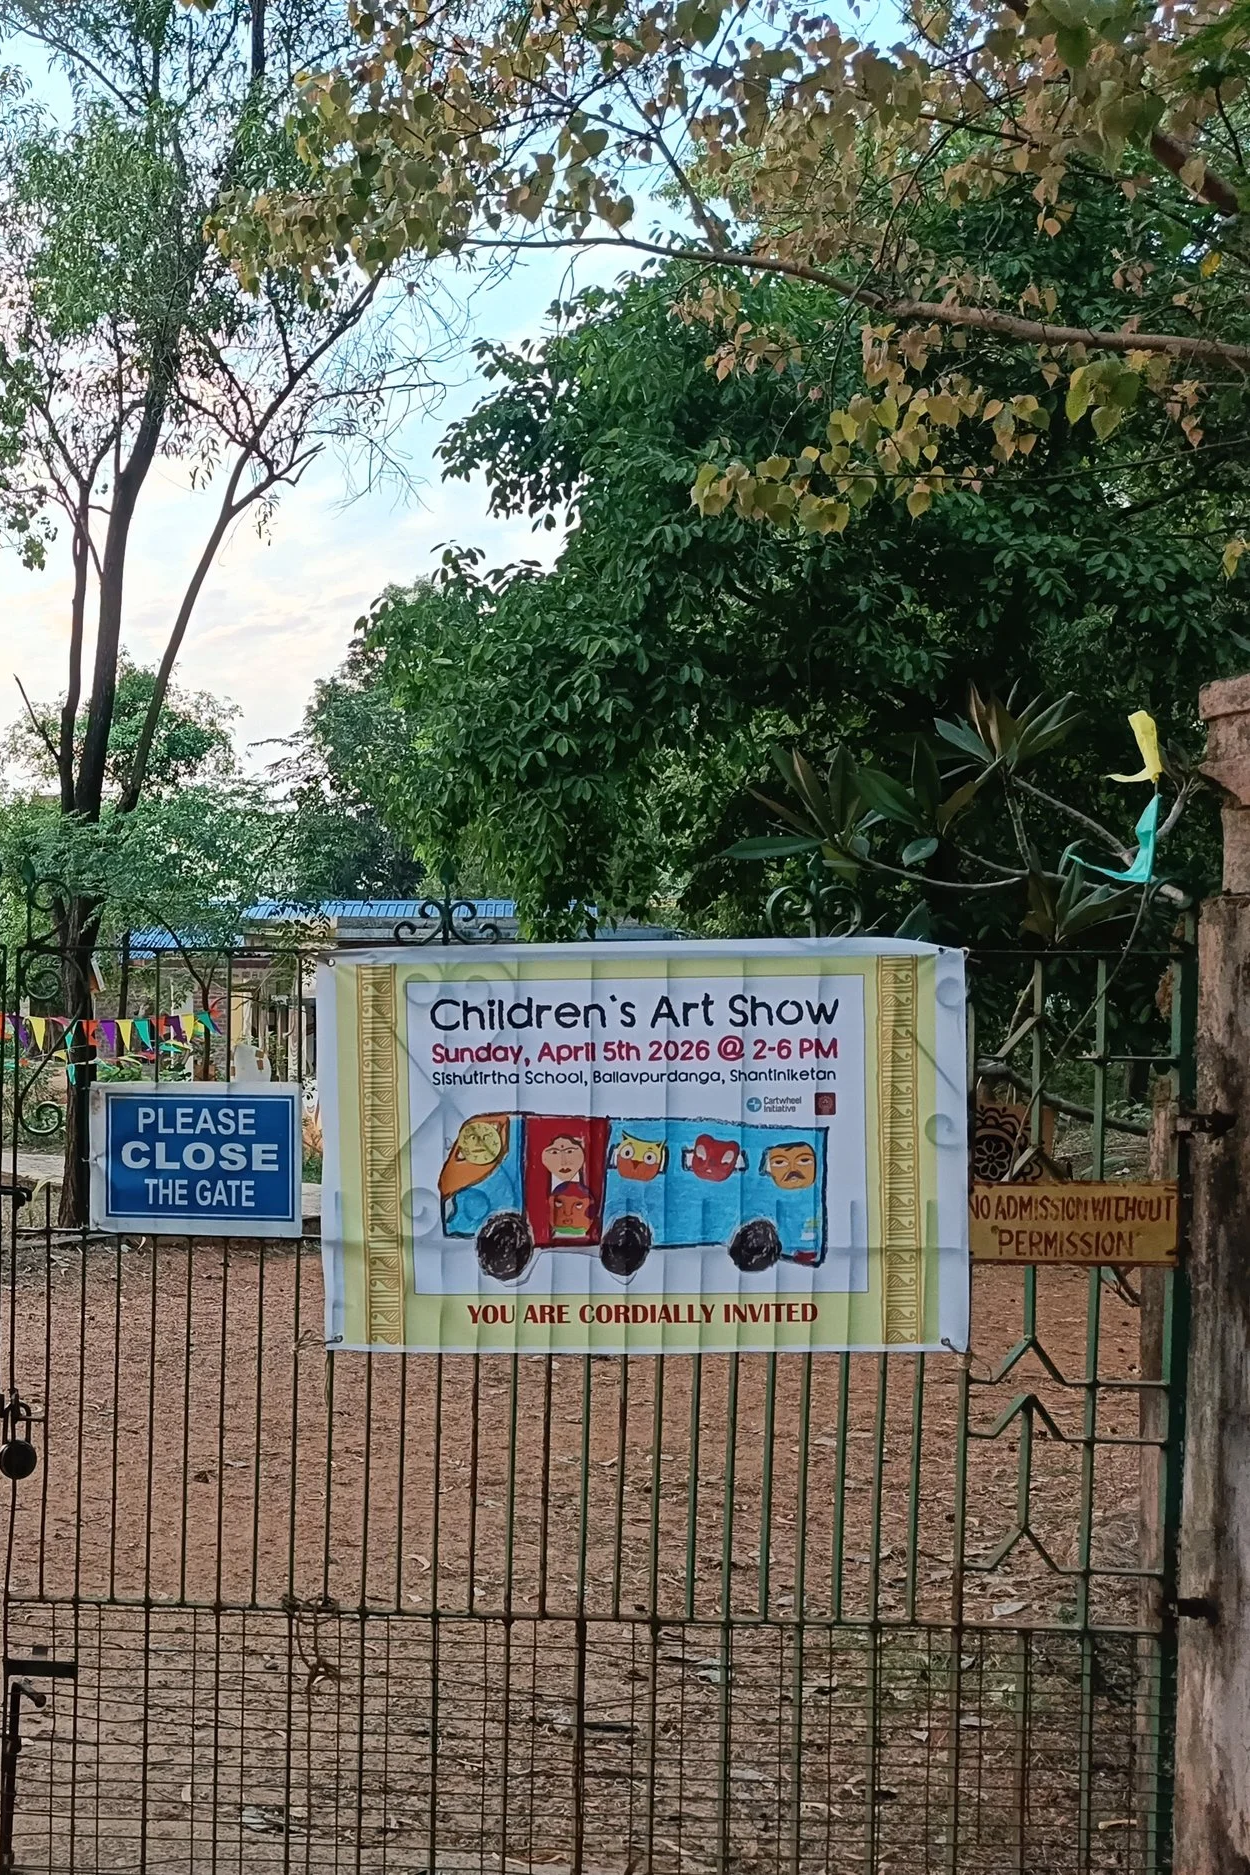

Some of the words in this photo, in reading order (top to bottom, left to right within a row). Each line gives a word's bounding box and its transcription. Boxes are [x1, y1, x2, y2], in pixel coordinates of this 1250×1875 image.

[430, 994, 636, 1031] Children's
[650, 992, 714, 1028] Art
[728, 994, 839, 1027] Show
[432, 1042, 530, 1067] Sunday,
[538, 1041, 596, 1065] April
[603, 1040, 641, 1061] 5th
[648, 1040, 710, 1062] 2026
[717, 1034, 745, 1062] @
[752, 1039, 792, 1060] 2-6
[799, 1037, 838, 1059] PM
[432, 1070, 519, 1086] Sishutirtha
[524, 1070, 588, 1087] School,
[593, 1069, 725, 1085] Ballavpurdanga,
[729, 1067, 836, 1083] Shantiniketan
[763, 1096, 802, 1105] Cartwheel
[763, 1104, 796, 1112] Initiative
[137, 1107, 256, 1135] PLEASE
[121, 1140, 279, 1171] CLOSE
[144, 1178, 188, 1206] THE
[196, 1179, 255, 1207] GATE
[995, 1195, 1088, 1222] ADMISSION
[1092, 1195, 1175, 1223] WITHOUT
[467, 1304, 516, 1324] YOU
[523, 1304, 571, 1324] ARE
[579, 1303, 715, 1324] CORDIALLY
[724, 1303, 818, 1323] INVITED
